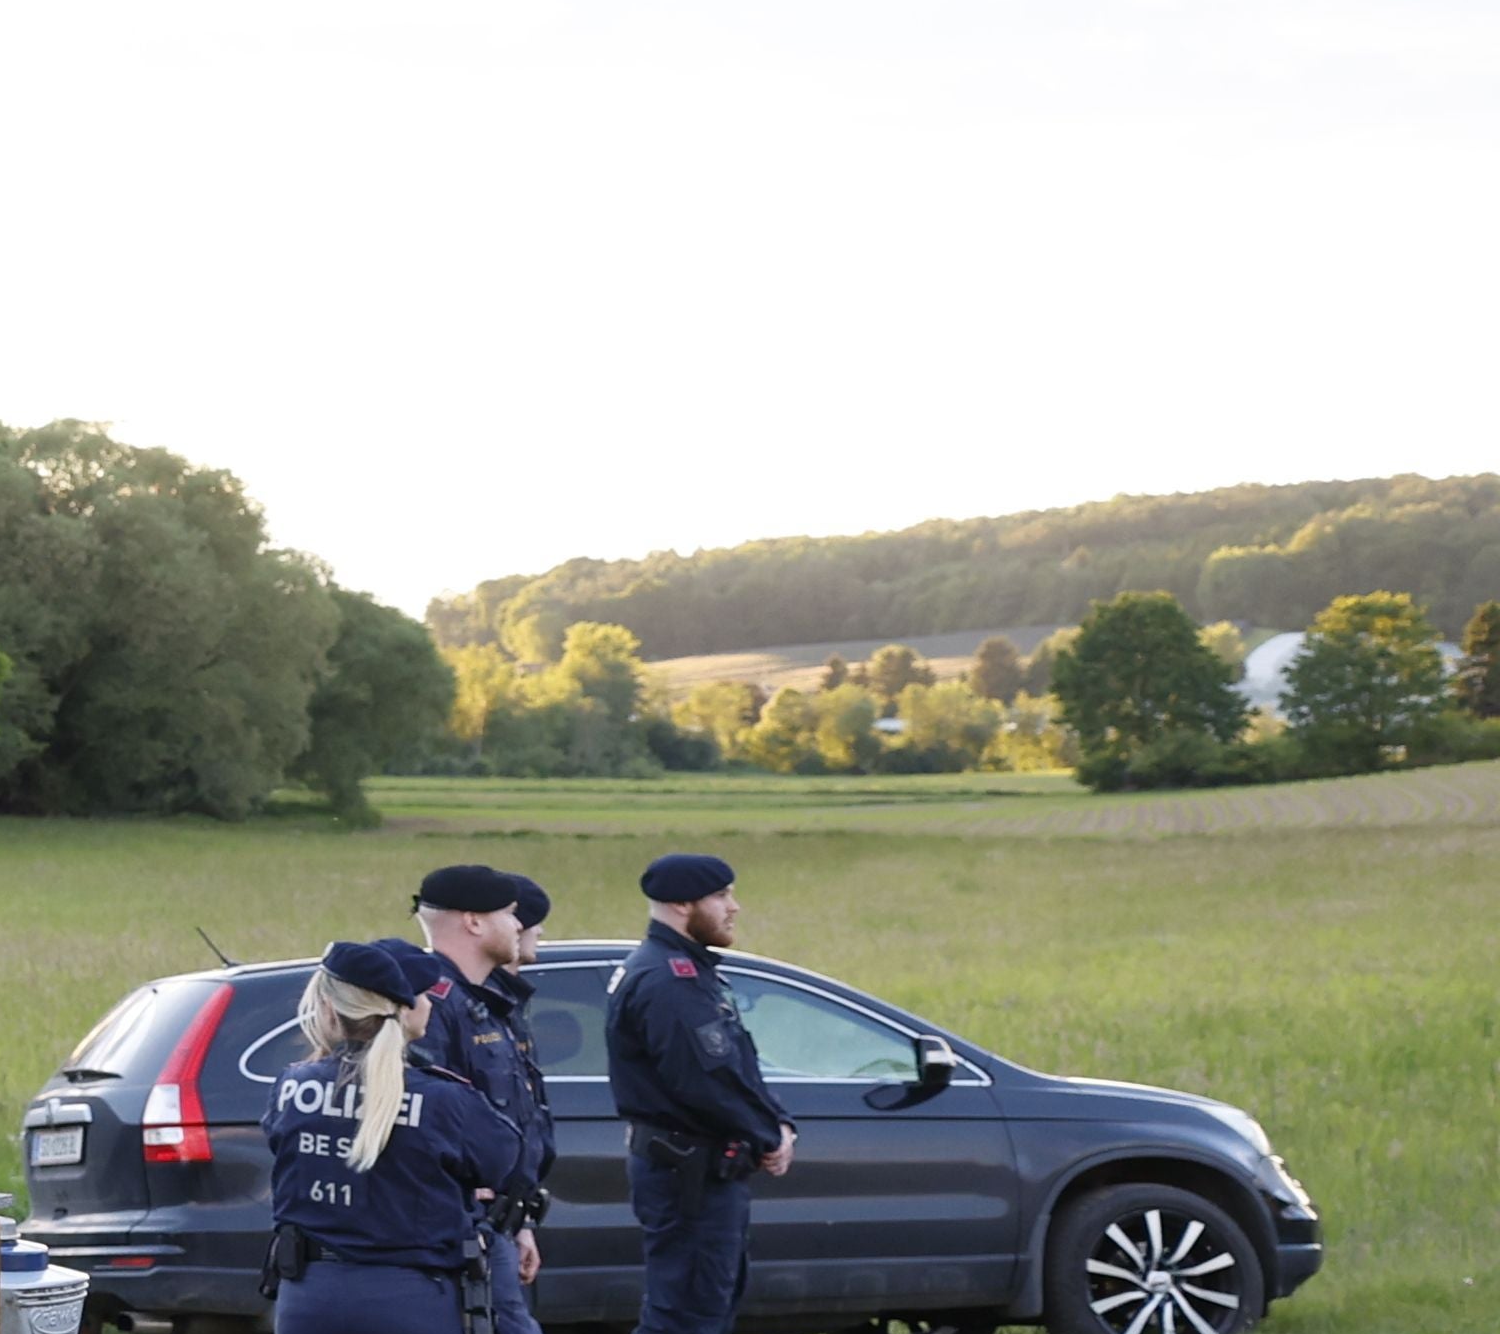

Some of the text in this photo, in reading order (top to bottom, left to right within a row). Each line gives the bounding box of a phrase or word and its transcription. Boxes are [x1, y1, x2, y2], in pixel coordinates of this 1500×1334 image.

[277, 1078, 423, 1127] POLIEI
[299, 1132, 331, 1156] BE
[310, 1180, 352, 1206] 611
